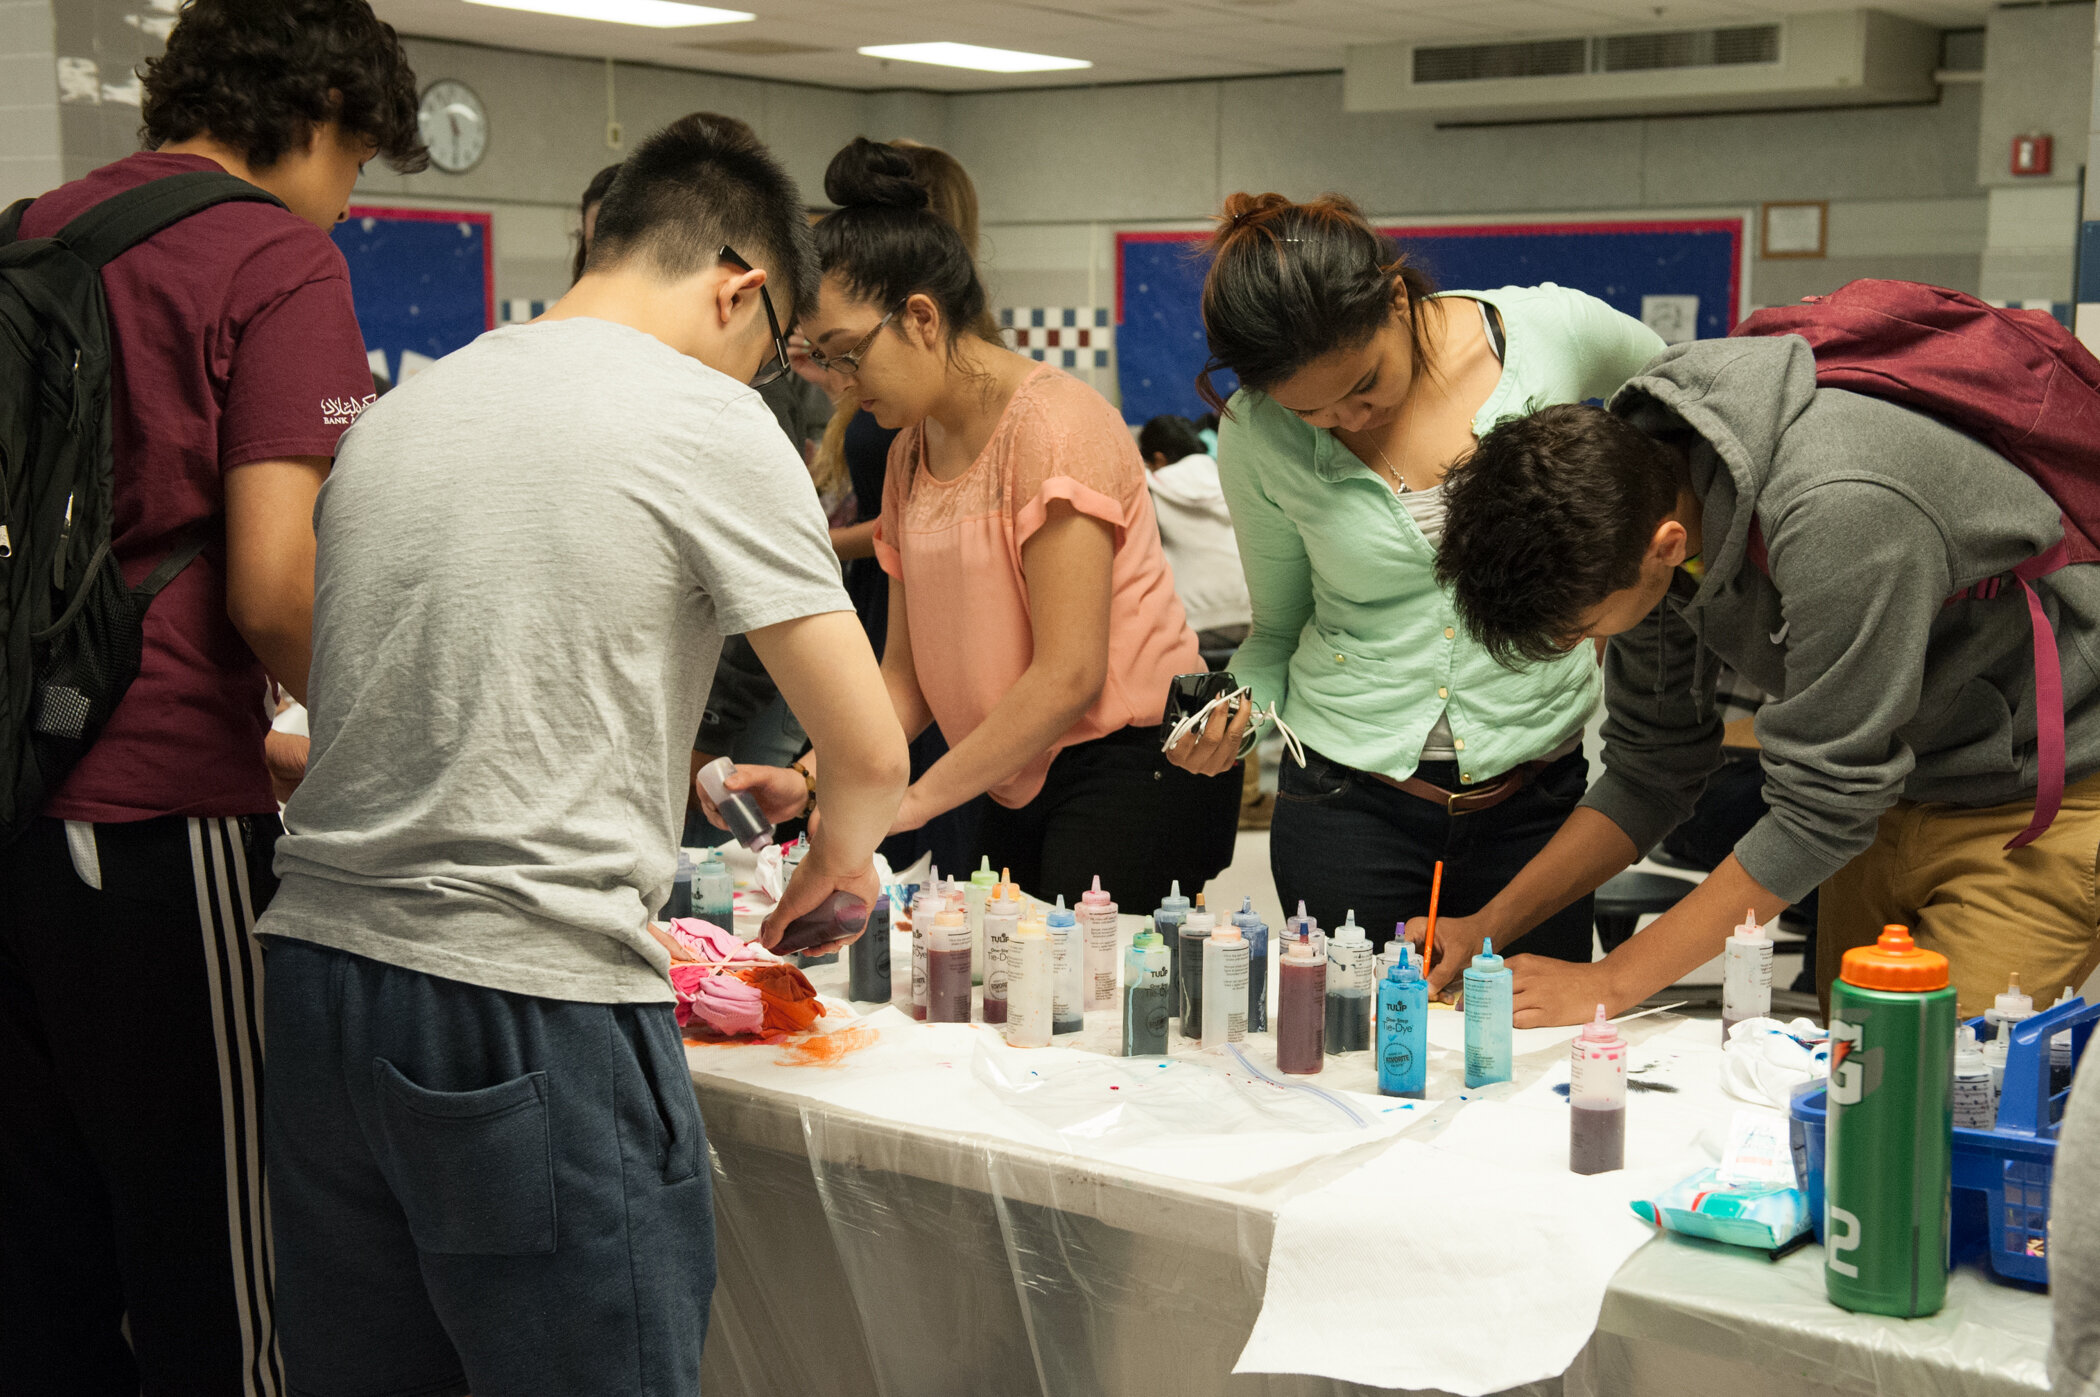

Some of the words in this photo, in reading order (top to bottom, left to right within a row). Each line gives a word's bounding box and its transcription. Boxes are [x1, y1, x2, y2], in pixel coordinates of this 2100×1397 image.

[323, 416, 349, 425] BANK
[991, 933, 1009, 943] TULIP
[1151, 966, 1168, 978] TULIP
[1386, 1000, 1408, 1012] TULIP
[1383, 1020, 1413, 1036] Tie-Dye
